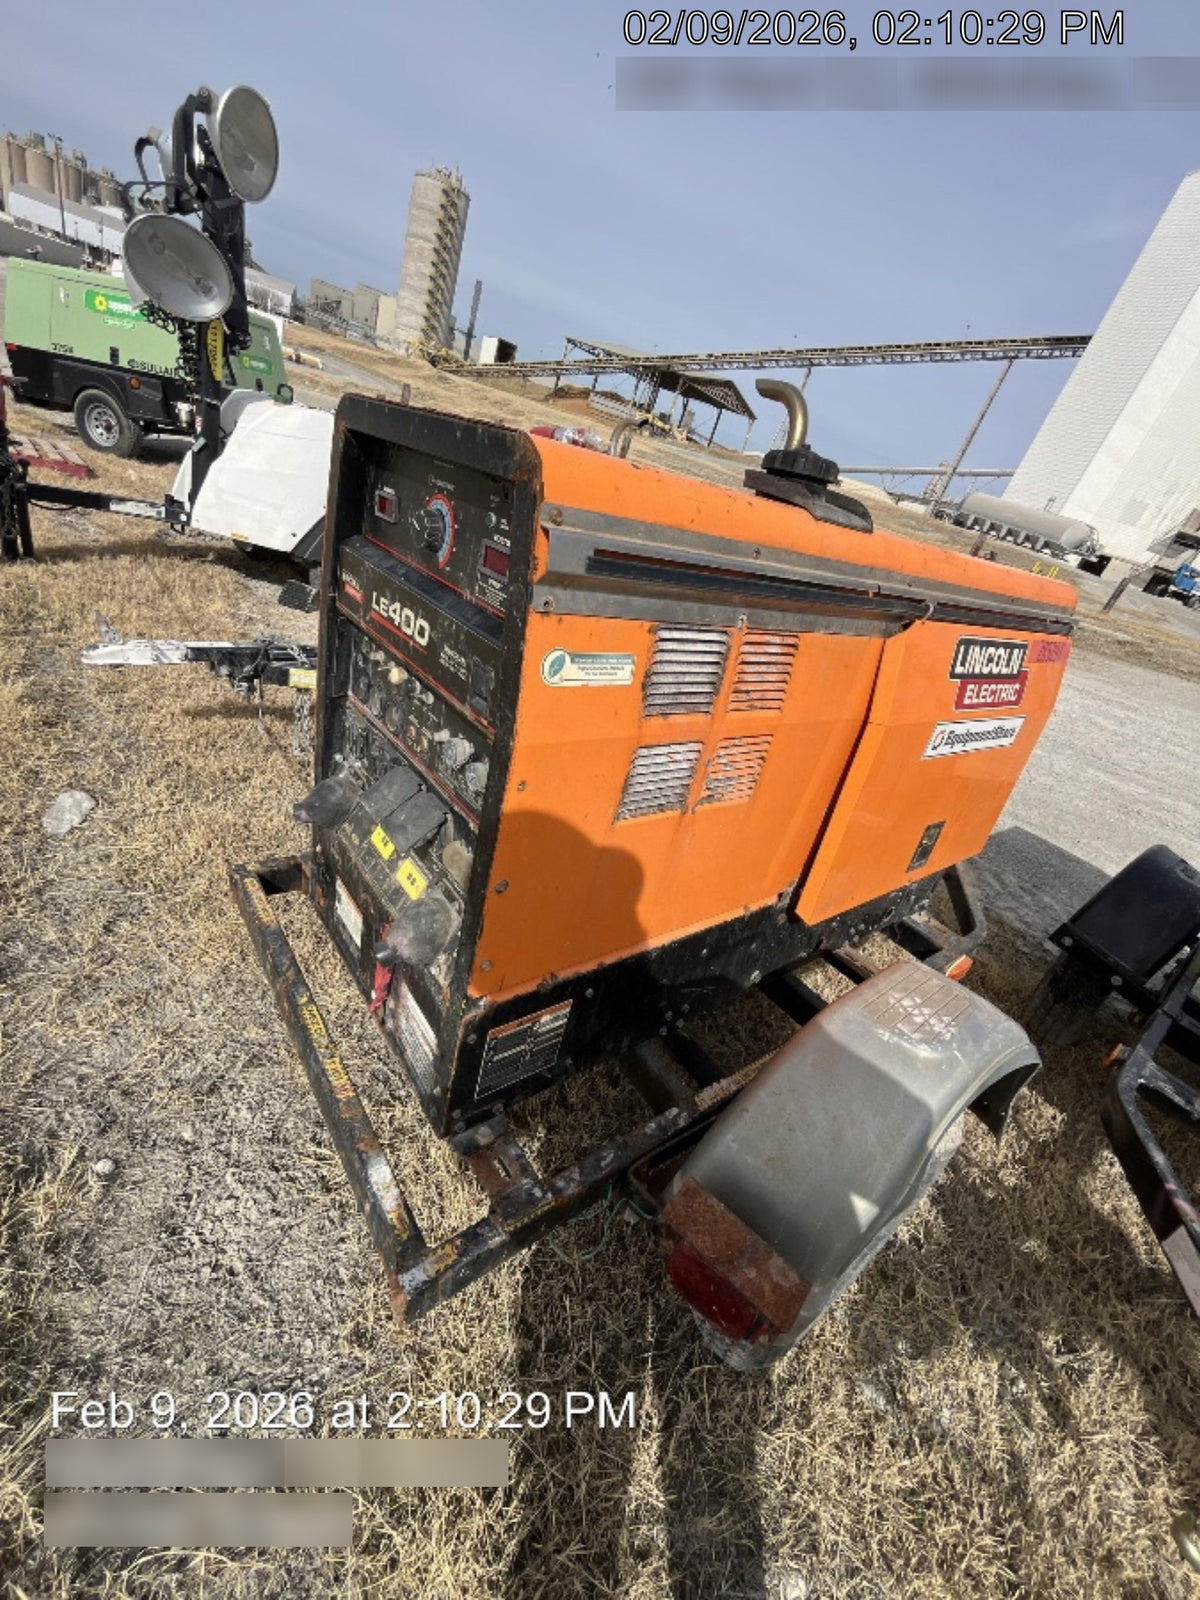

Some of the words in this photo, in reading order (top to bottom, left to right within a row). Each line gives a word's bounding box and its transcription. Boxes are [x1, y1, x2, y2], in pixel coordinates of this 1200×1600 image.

[372, 591, 430, 646] LE400
[955, 645, 1023, 674] LINCOLN
[963, 683, 1020, 704] ELECTRIC
